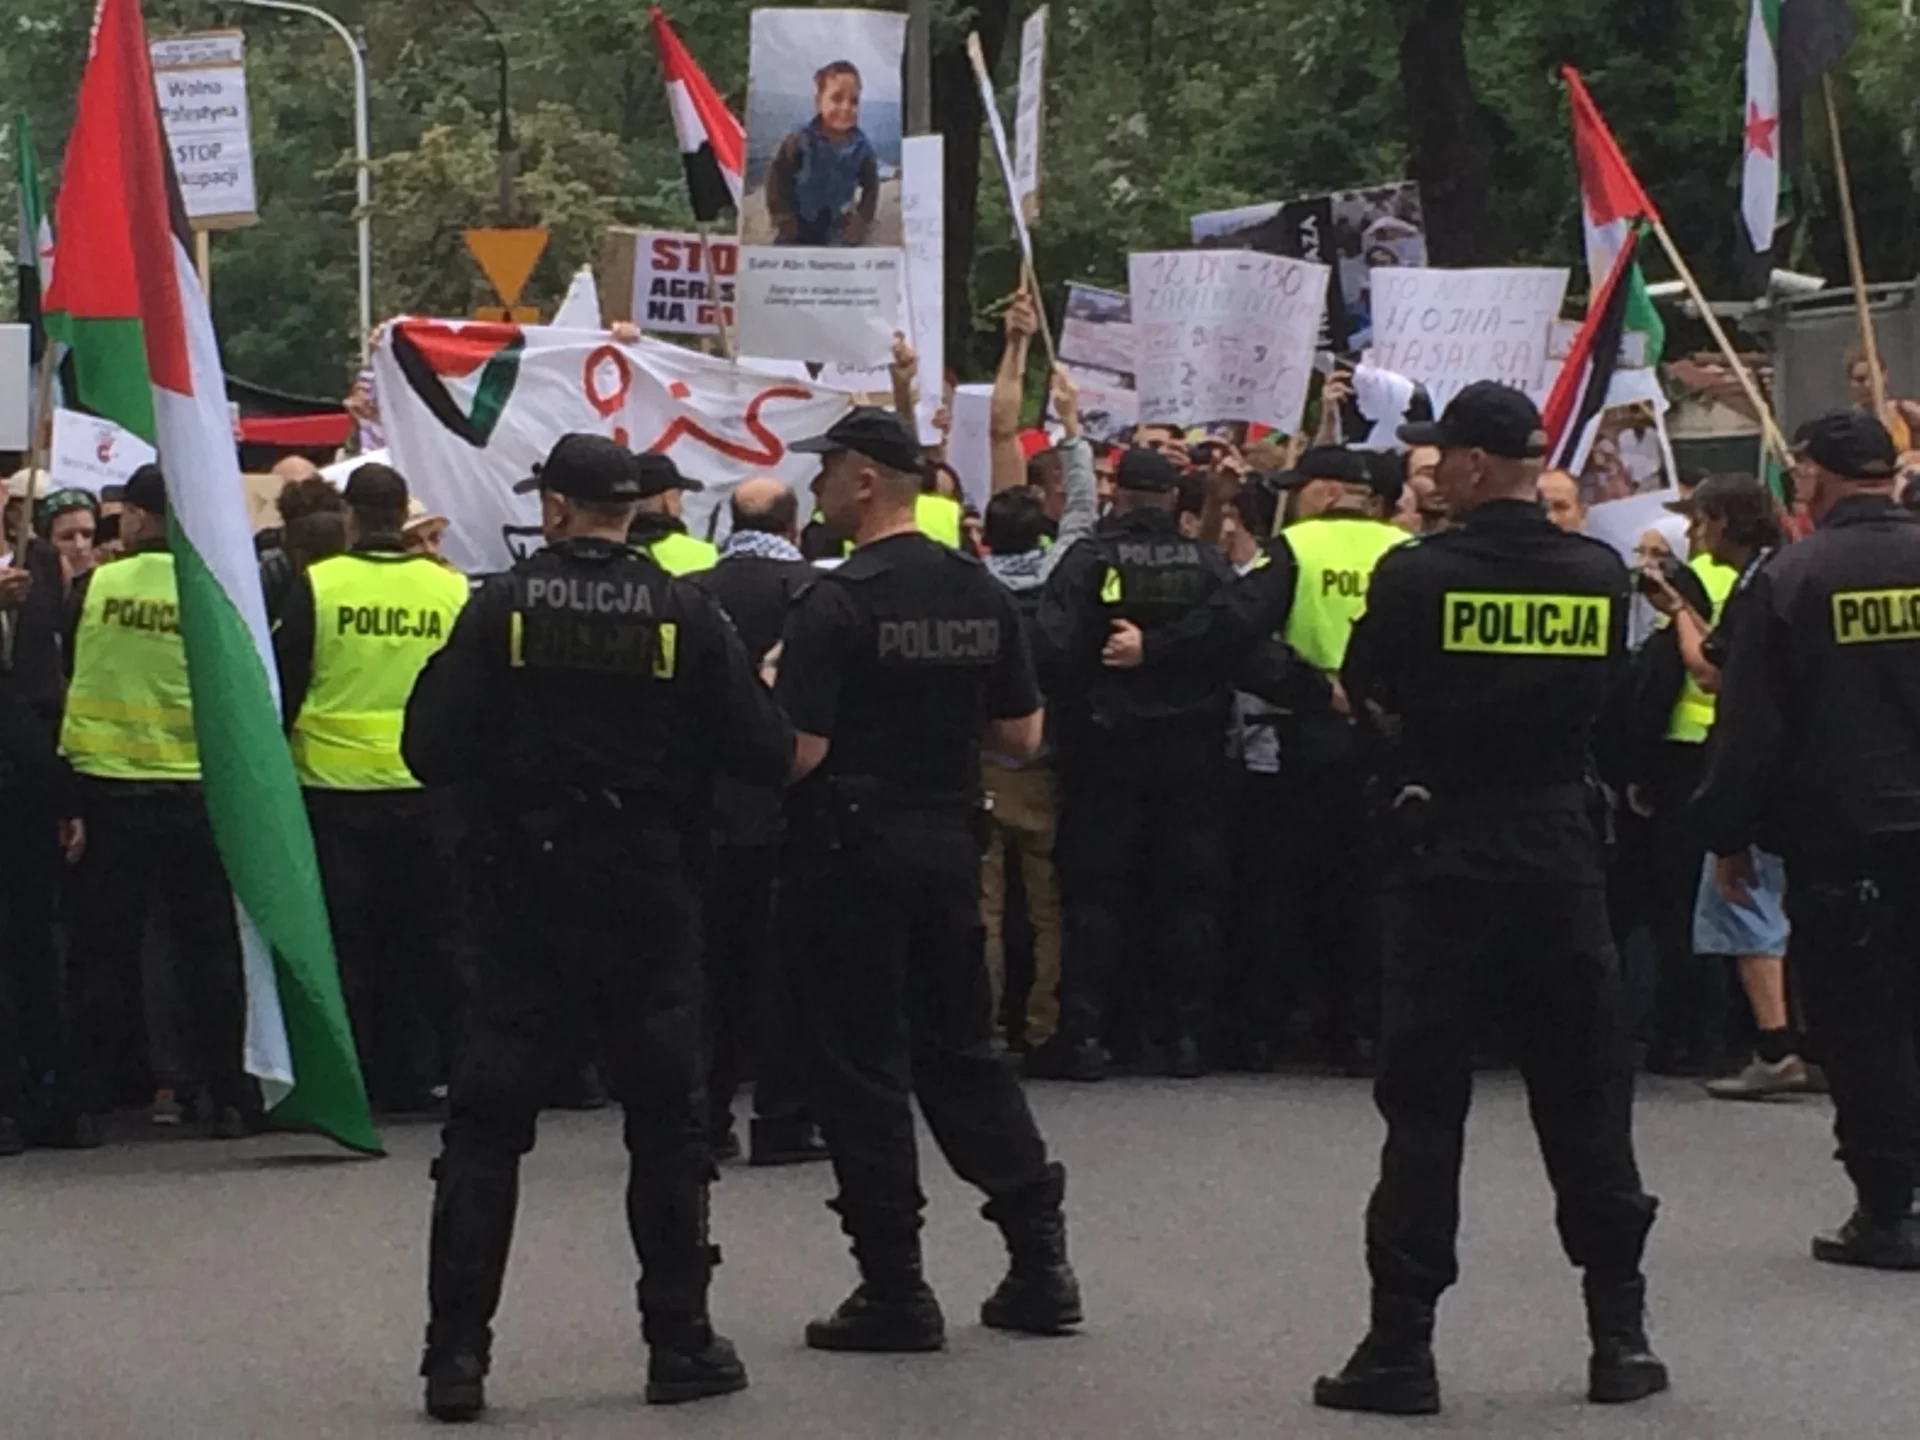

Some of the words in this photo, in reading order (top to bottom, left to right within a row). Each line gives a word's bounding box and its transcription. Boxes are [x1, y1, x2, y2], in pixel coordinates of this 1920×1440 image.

[177, 143, 222, 163] STOP
[180, 167, 239, 188] kupacji
[651, 239, 738, 275] STO
[647, 301, 685, 323] NA
[527, 577, 653, 616] POLICJA
[1322, 569, 1364, 597] POL
[102, 597, 180, 634] POLIC
[338, 606, 441, 639] POLICJA
[1453, 601, 1598, 647] POLICJA
[1840, 594, 1920, 637] POLIC
[879, 619, 999, 660] POLICJA
